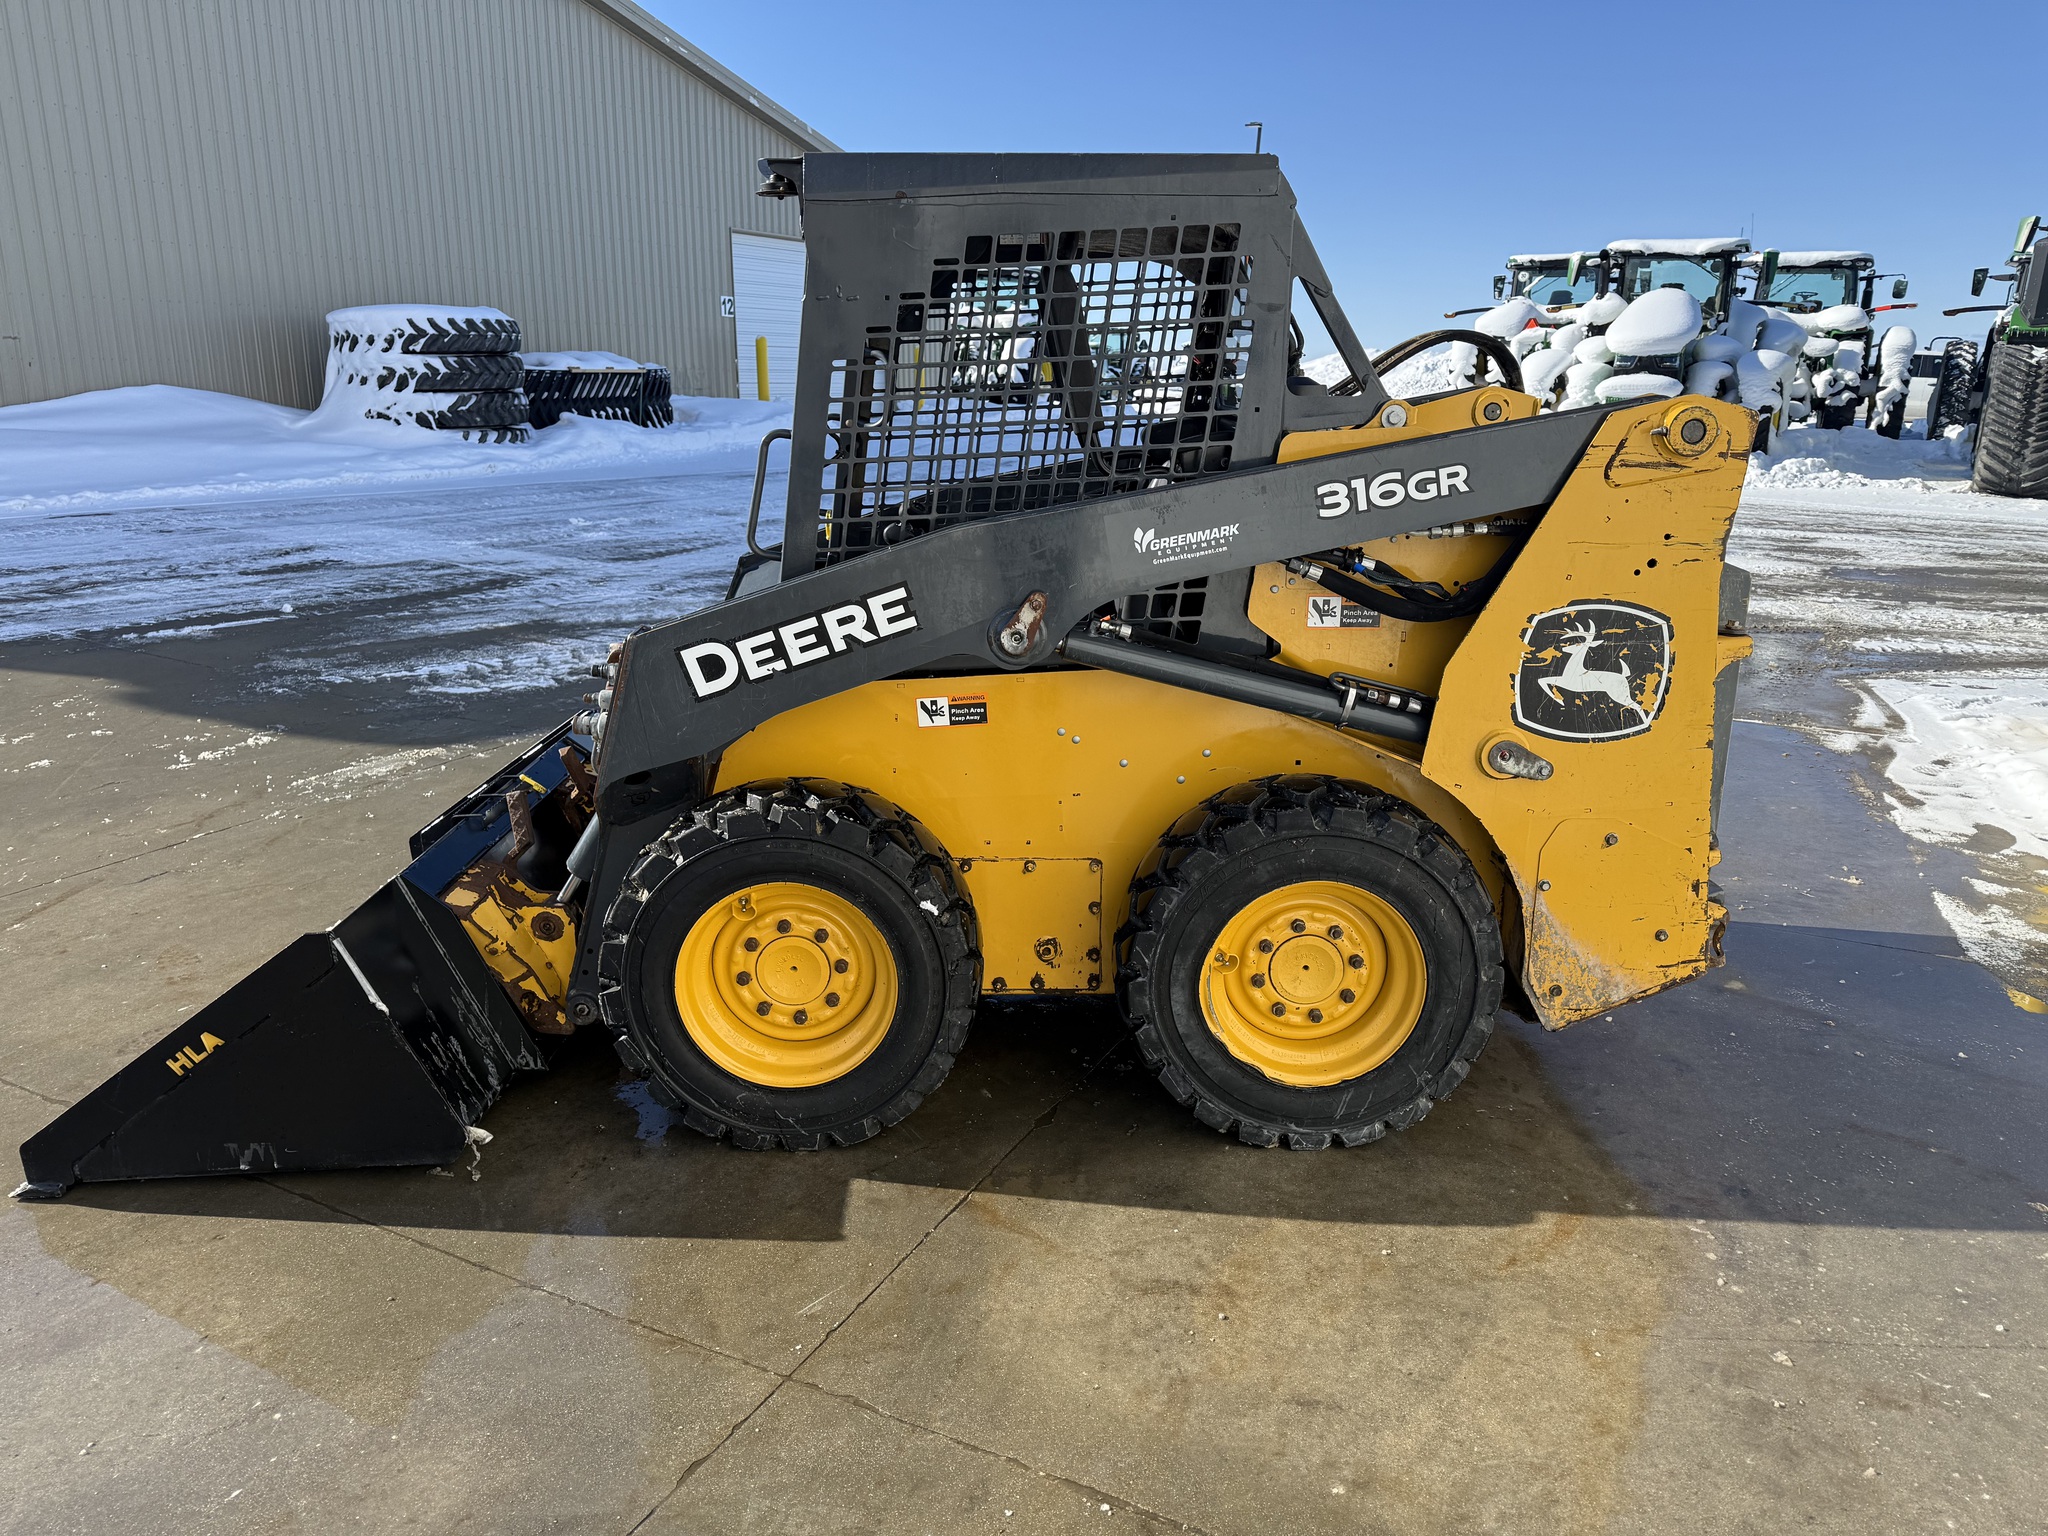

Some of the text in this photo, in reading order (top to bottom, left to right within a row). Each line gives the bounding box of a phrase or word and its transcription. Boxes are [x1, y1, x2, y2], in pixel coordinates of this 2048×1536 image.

[722, 298, 734, 316] 12
[1316, 464, 1470, 518] 316GR
[1150, 523, 1240, 551] GREENMARK
[1157, 537, 1234, 556] EQUIPMENT
[1152, 546, 1228, 565] GreenMarkEquipment.com
[680, 586, 918, 698] DEERE
[165, 1031, 226, 1077] HLA
